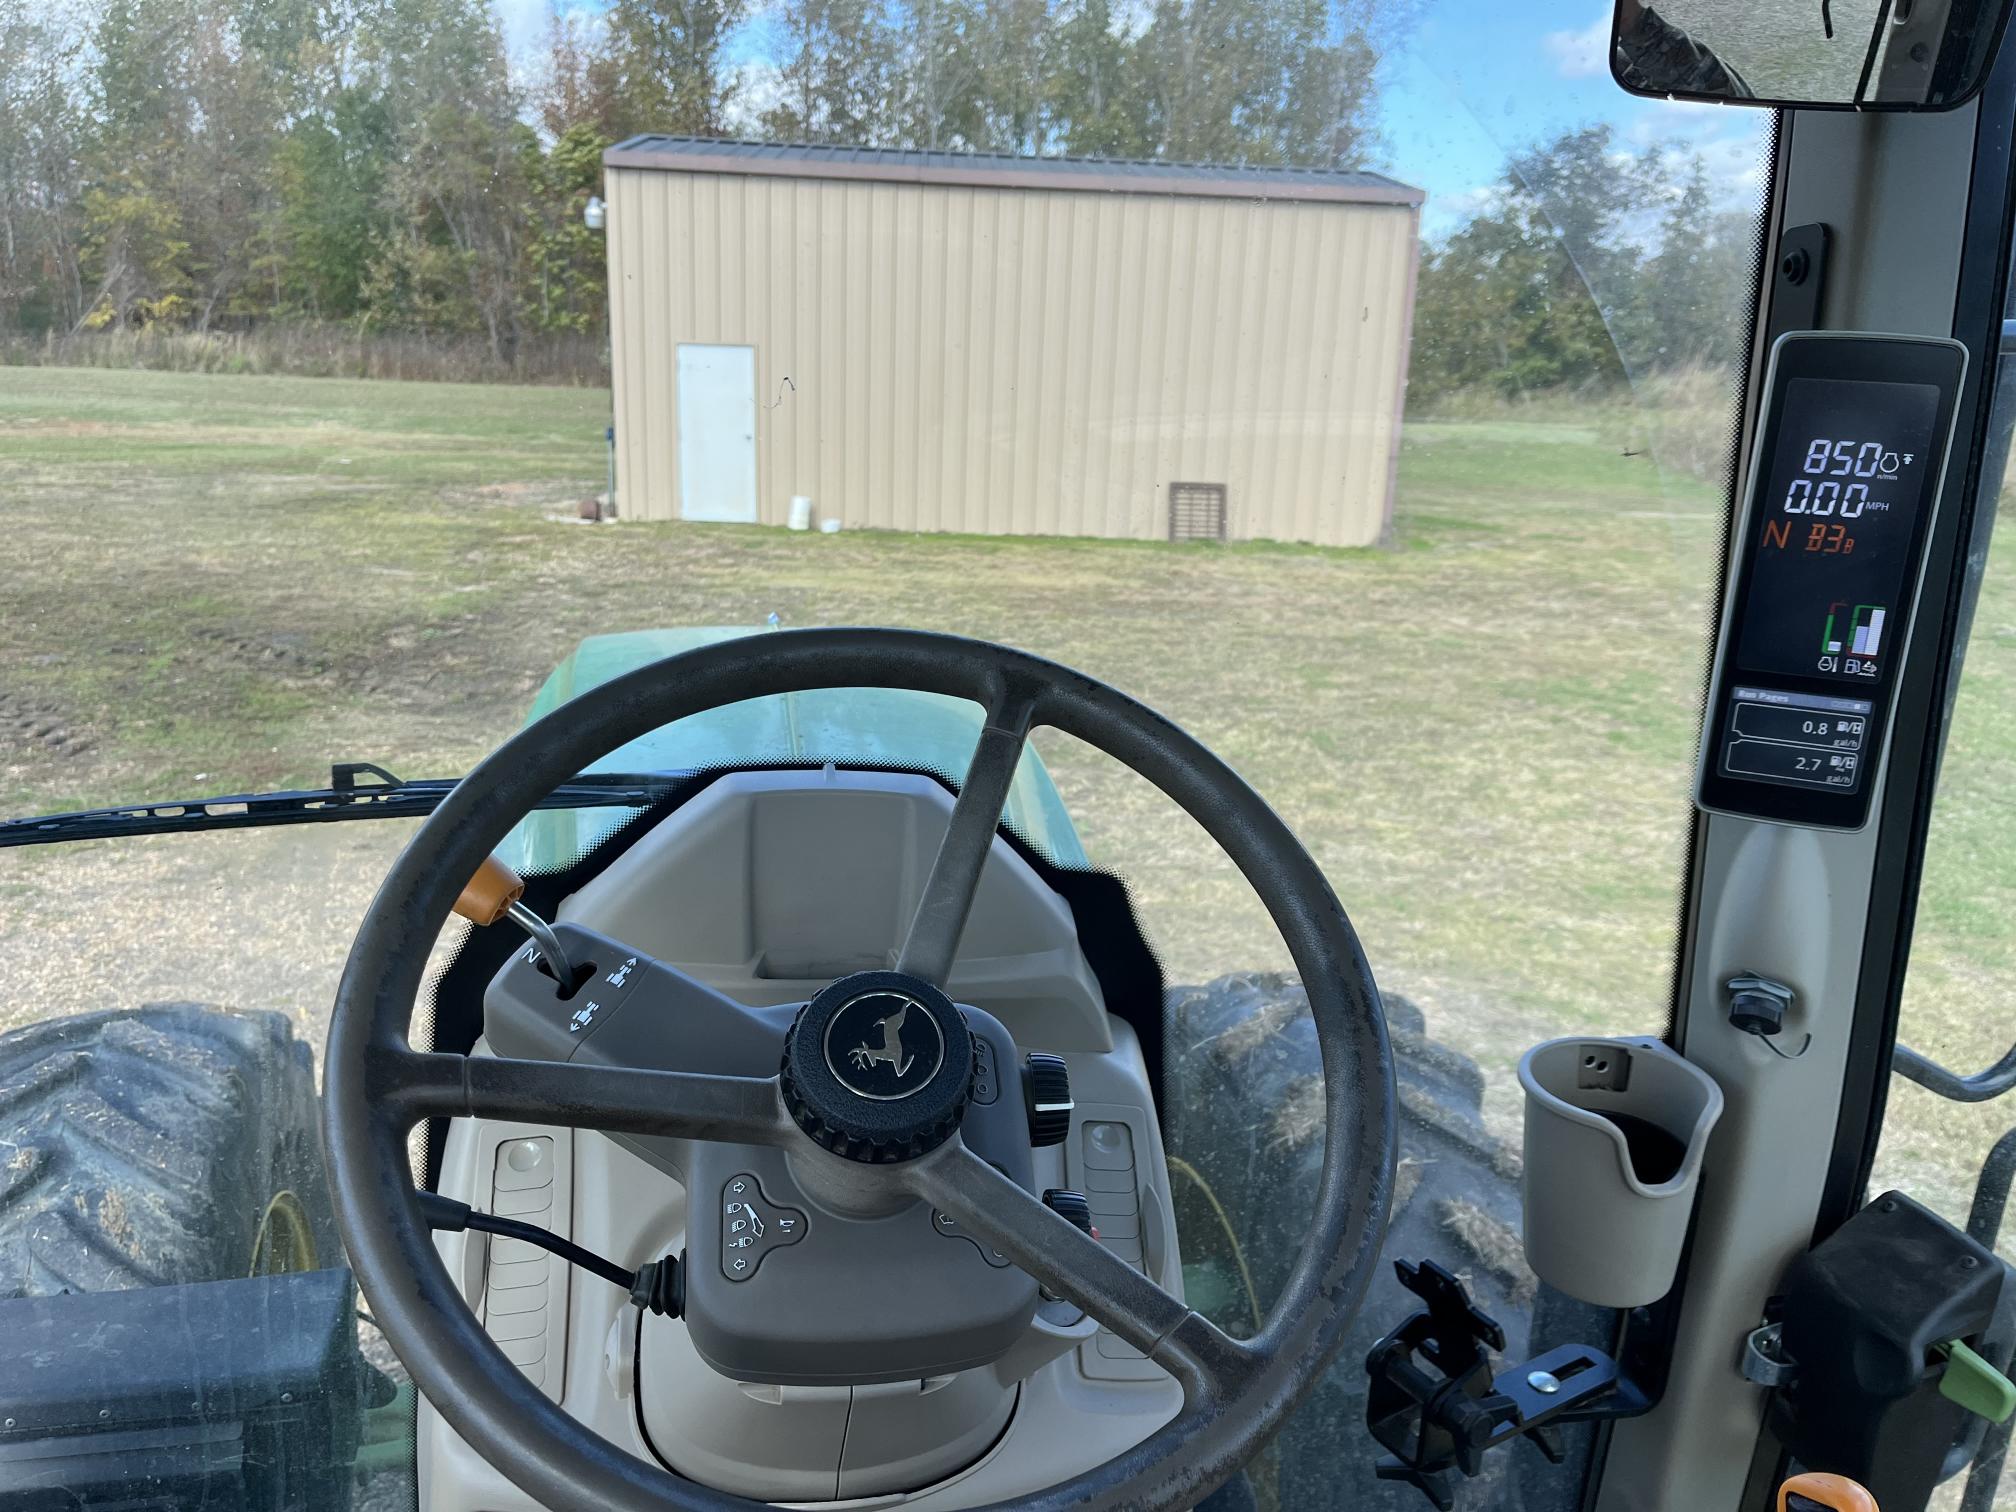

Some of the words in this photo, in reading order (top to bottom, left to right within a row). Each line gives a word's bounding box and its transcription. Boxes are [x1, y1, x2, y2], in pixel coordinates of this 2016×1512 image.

[1804, 439, 1882, 477] 850
[1784, 479, 1868, 518] 0.00
[1865, 502, 1889, 511] MPH
[1763, 520, 1791, 548] N
[1738, 690, 1757, 699] Run
[1759, 692, 1789, 703] Pages
[1802, 721, 1828, 735] 0.8
[1833, 738, 1857, 748] gal/h
[1795, 757, 1822, 771] 2.7
[1826, 775, 1850, 784] gal/h
[521, 948, 541, 963] N
